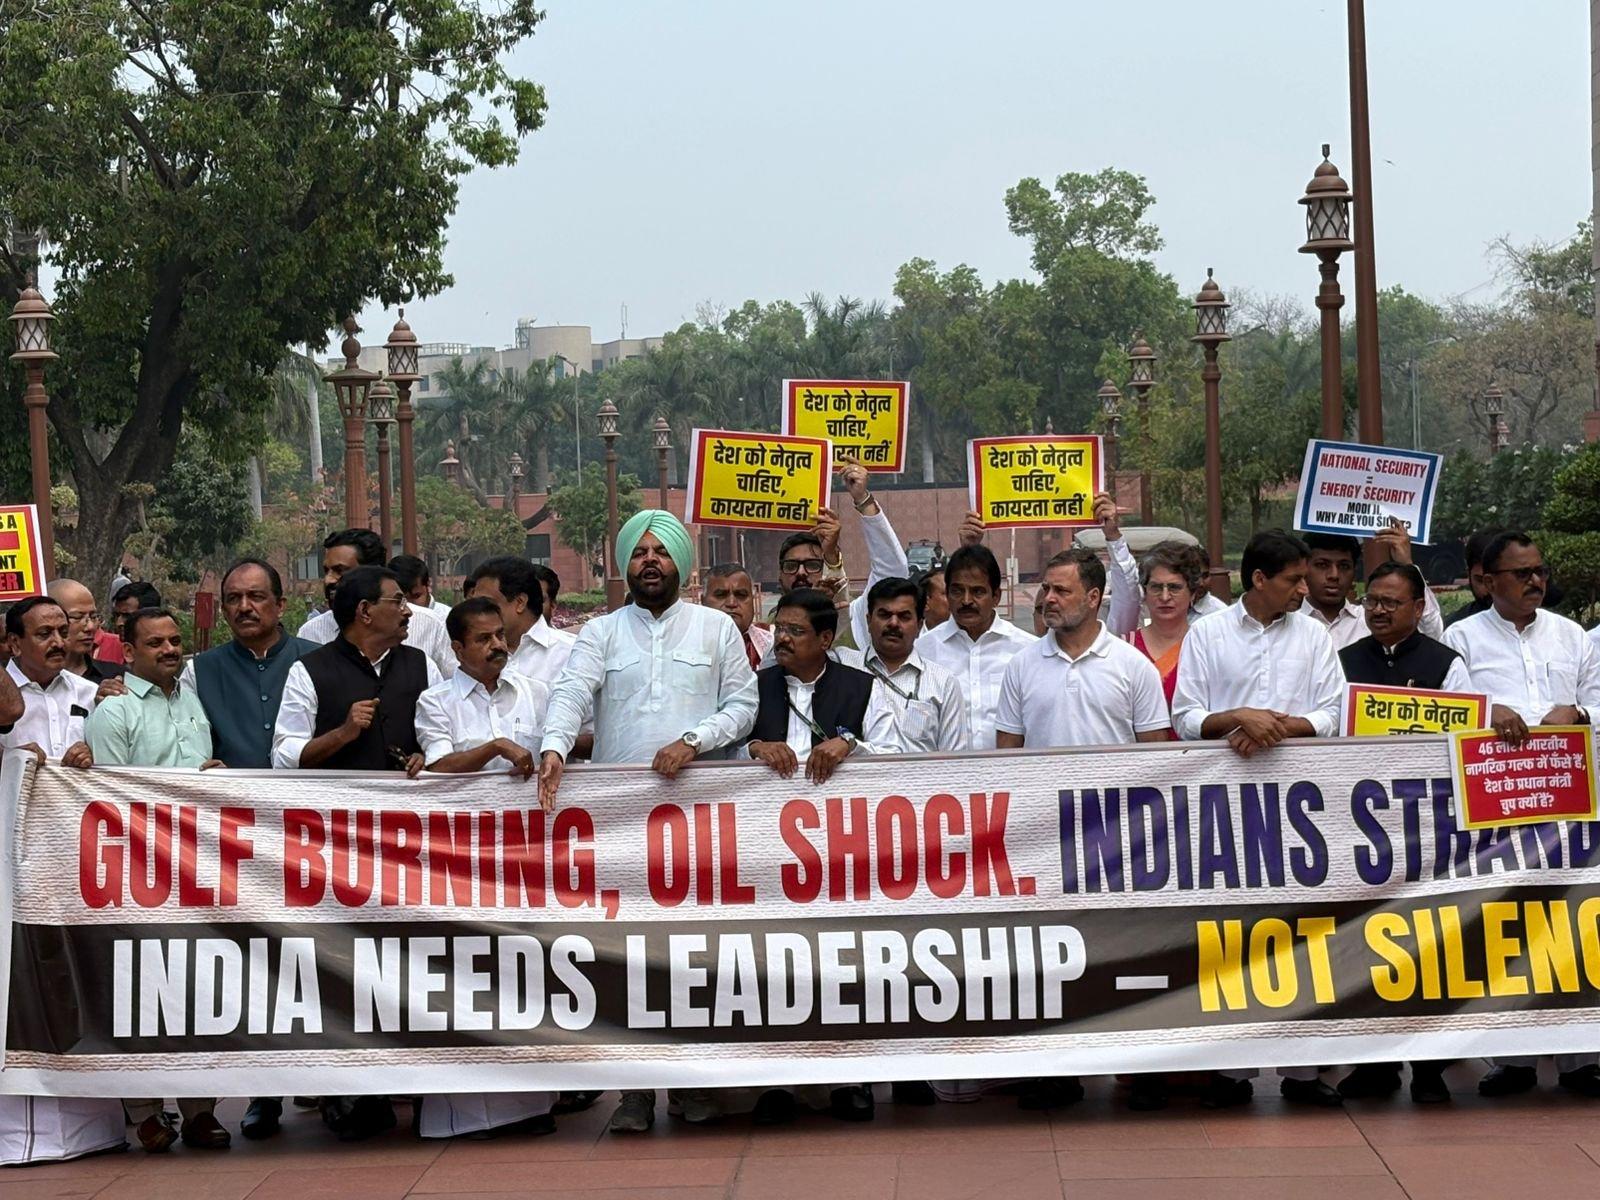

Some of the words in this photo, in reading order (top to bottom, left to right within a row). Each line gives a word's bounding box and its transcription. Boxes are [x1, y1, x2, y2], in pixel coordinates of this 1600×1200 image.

[803, 389, 828, 412] देश
[832, 389, 852, 412] को
[854, 389, 892, 419] नेतृत्व
[826, 414, 871, 440] चाहिए,
[713, 440, 740, 465] देश
[744, 442, 767, 467] को
[769, 443, 813, 477] नेतृत्व
[863, 440, 893, 462] नहीं
[988, 447, 1014, 468] देश
[1016, 445, 1038, 467] को
[1040, 444, 1084, 473] नेतृत्व
[1320, 453, 1371, 472] NATIONAL
[1374, 459, 1428, 478] SECURITY
[736, 469, 787, 498] चाहिए,
[1011, 469, 1060, 494] चाहिए,
[1320, 481, 1361, 499] ENERGY
[1363, 487, 1416, 505] SECURITY
[710, 498, 774, 519] कायरता
[776, 498, 813, 521] नहीं
[990, 499, 1050, 518] कायरता
[1052, 493, 1087, 516] नहीं
[1347, 502, 1371, 514] MODI
[1316, 511, 1337, 523] WHY
[1337, 512, 1355, 525] ARE
[1356, 515, 1375, 527] YOU
[1376, 516, 1412, 530] SILT?
[1364, 694, 1393, 720] देश
[1396, 697, 1420, 721] को
[1423, 699, 1470, 732] नेतृत्व
[1478, 742, 1493, 755] 46
[1526, 735, 1568, 751] भारतीय
[1464, 758, 1506, 776] नागरिक
[1507, 758, 1534, 772] गल्फ
[1536, 754, 1549, 770] में
[1484, 778, 1501, 794] देश
[1503, 776, 1515, 791] के
[1516, 778, 1546, 791] प्रधान
[1548, 772, 1572, 788] मंत्री
[1500, 797, 1516, 815] चुप
[79, 800, 256, 909] GULF
[283, 807, 619, 920] BURNING,
[647, 803, 755, 907] OIL
[779, 791, 1037, 904] SHOCK.
[1058, 780, 1329, 895] INDIANS
[113, 936, 323, 1038] INDIA
[353, 934, 597, 1033] NEEDS
[625, 925, 1087, 1030] LEADERSHIP
[1196, 916, 1336, 1012] NOT
